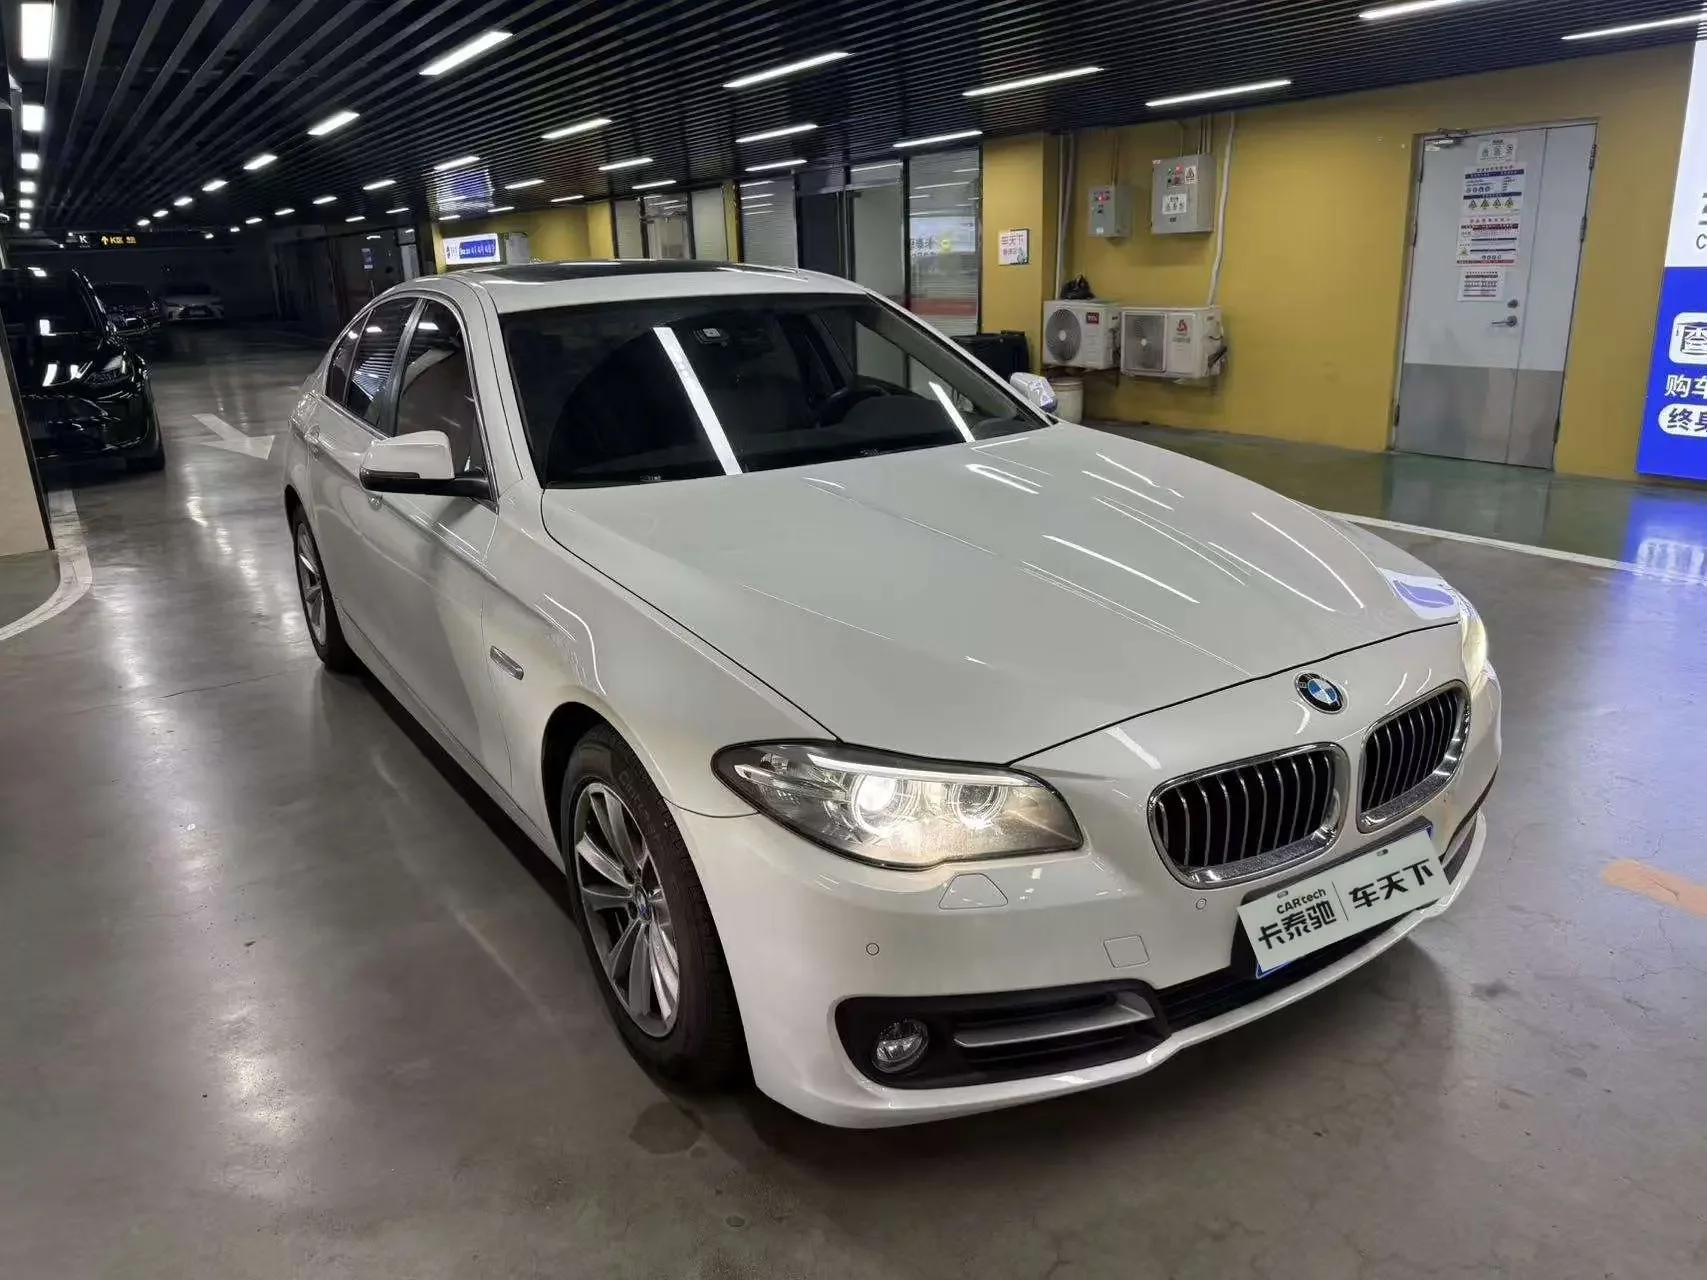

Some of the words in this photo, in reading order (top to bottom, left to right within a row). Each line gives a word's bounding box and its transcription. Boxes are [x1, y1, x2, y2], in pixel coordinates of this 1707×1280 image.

[1348, 858, 1434, 909] 车天下
[1258, 900, 1337, 950] 卡泰驰
